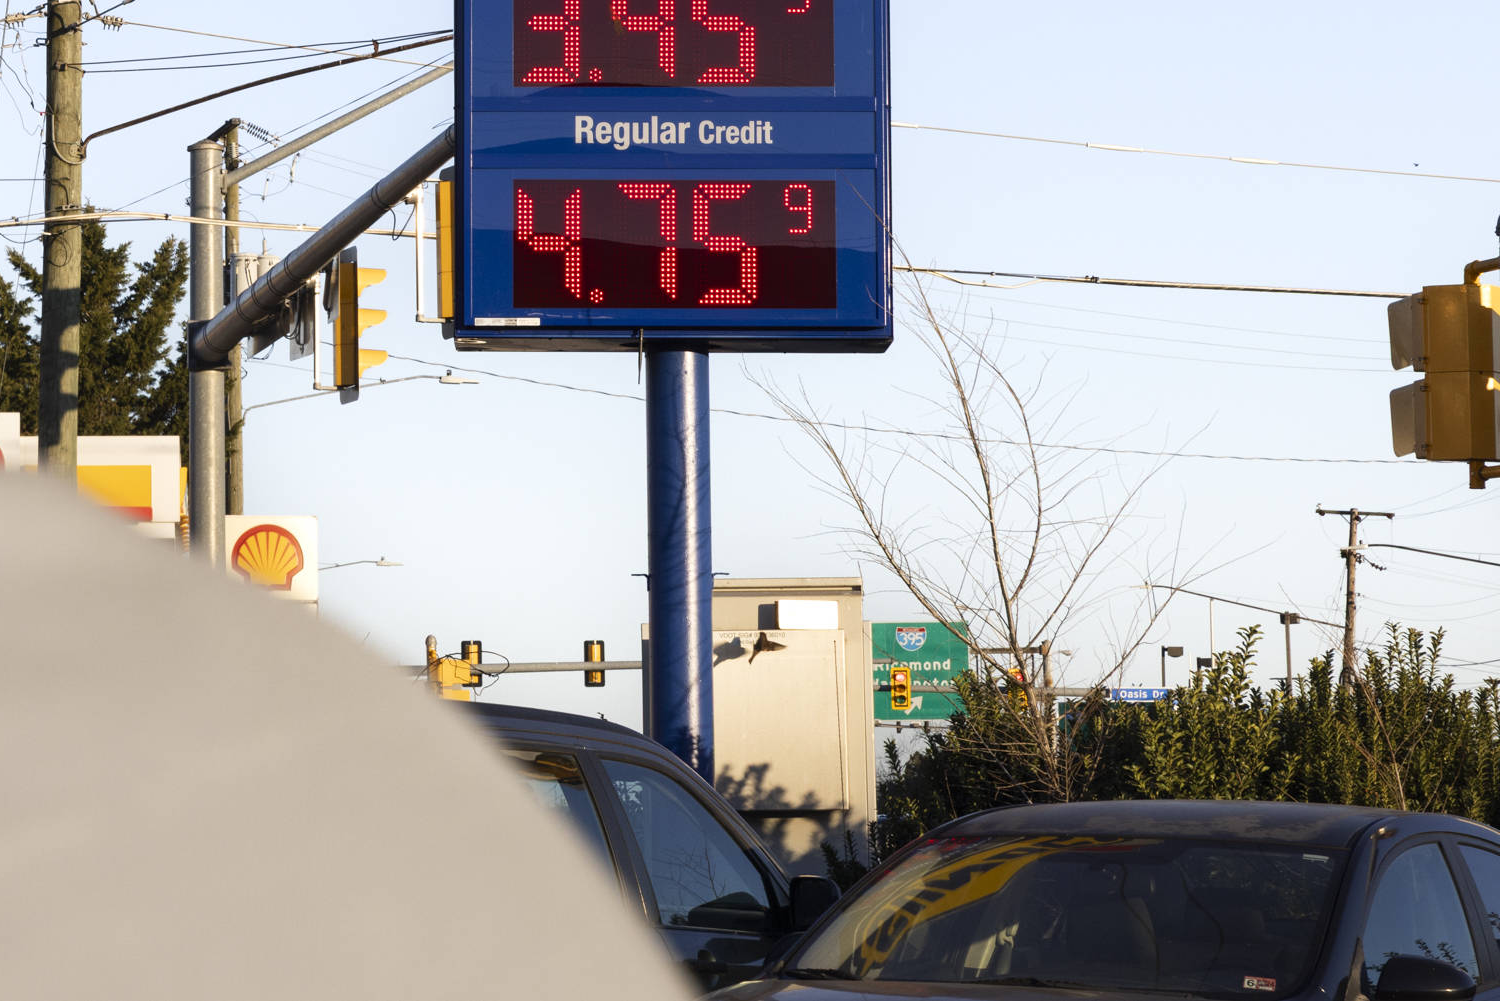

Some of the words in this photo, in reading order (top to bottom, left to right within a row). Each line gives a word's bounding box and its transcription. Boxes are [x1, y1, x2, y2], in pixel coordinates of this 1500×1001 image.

[574, 115, 691, 150] Regular
[698, 120, 773, 144] Credit
[899, 631, 924, 646] 395
[873, 658, 951, 671] Ricmond
[1120, 689, 1148, 699] Oasis
[1152, 689, 1165, 699] Dr
